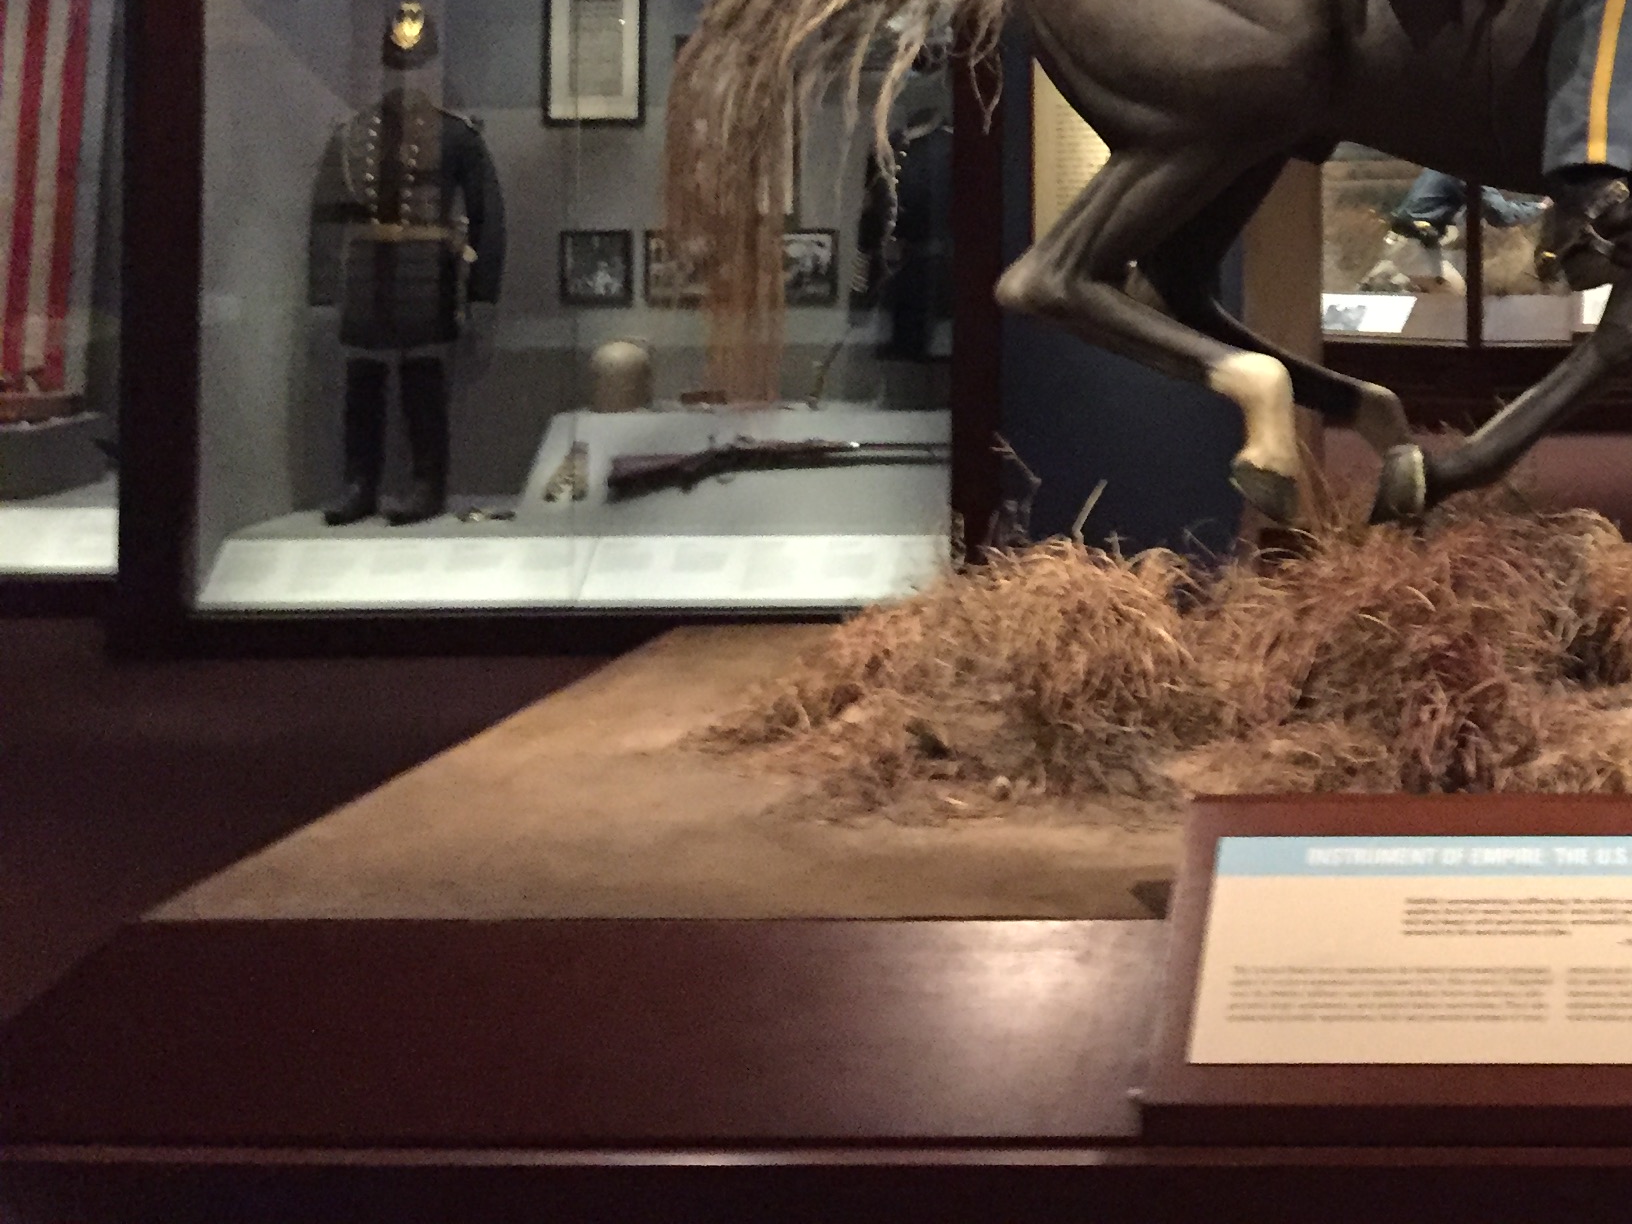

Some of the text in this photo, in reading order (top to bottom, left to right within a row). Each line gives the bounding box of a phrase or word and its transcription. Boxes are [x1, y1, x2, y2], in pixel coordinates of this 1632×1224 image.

[1307, 846, 1437, 866] INSTRUMENT
[1441, 847, 1464, 866] OF
[1552, 846, 1589, 866] THE
